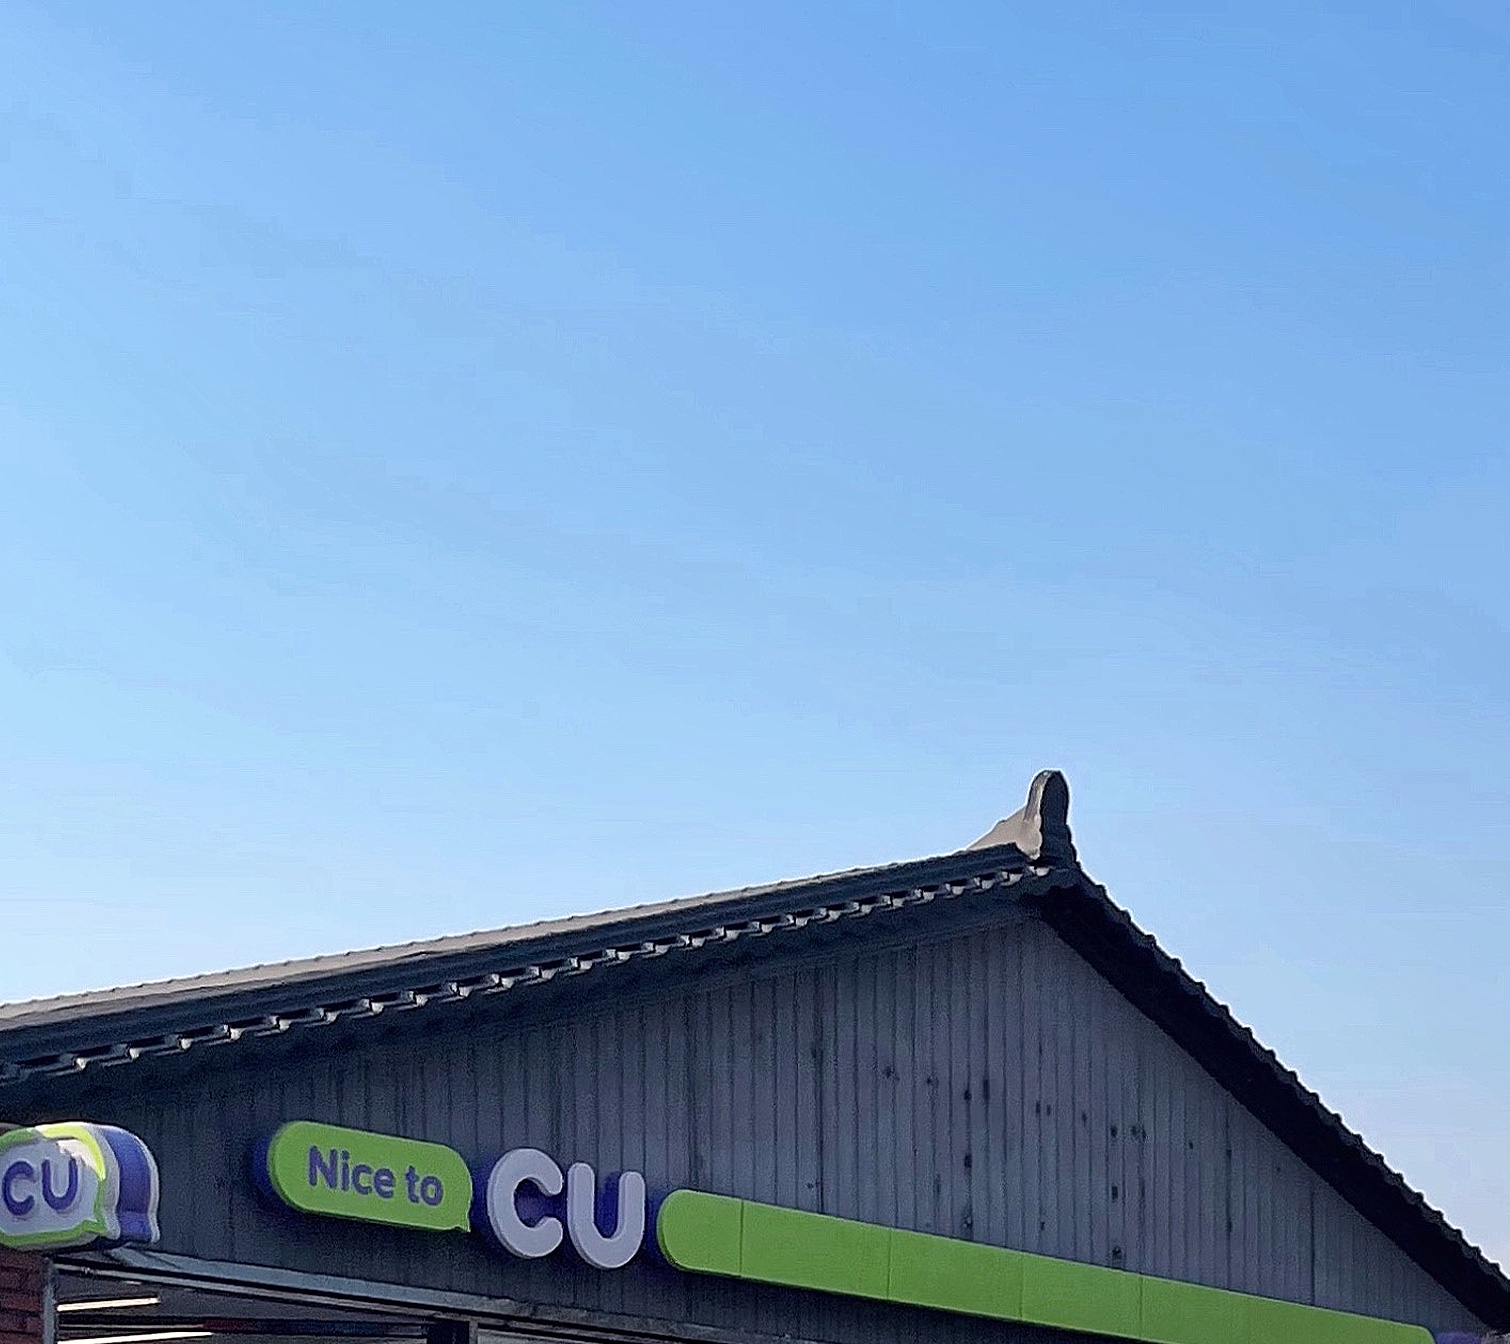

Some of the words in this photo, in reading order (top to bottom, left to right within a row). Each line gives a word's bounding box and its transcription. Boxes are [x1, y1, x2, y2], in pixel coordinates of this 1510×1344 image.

[3, 1160, 79, 1216] CU
[308, 1145, 395, 1199] Nice
[405, 1164, 444, 1207] to
[487, 1148, 646, 1269] CU
